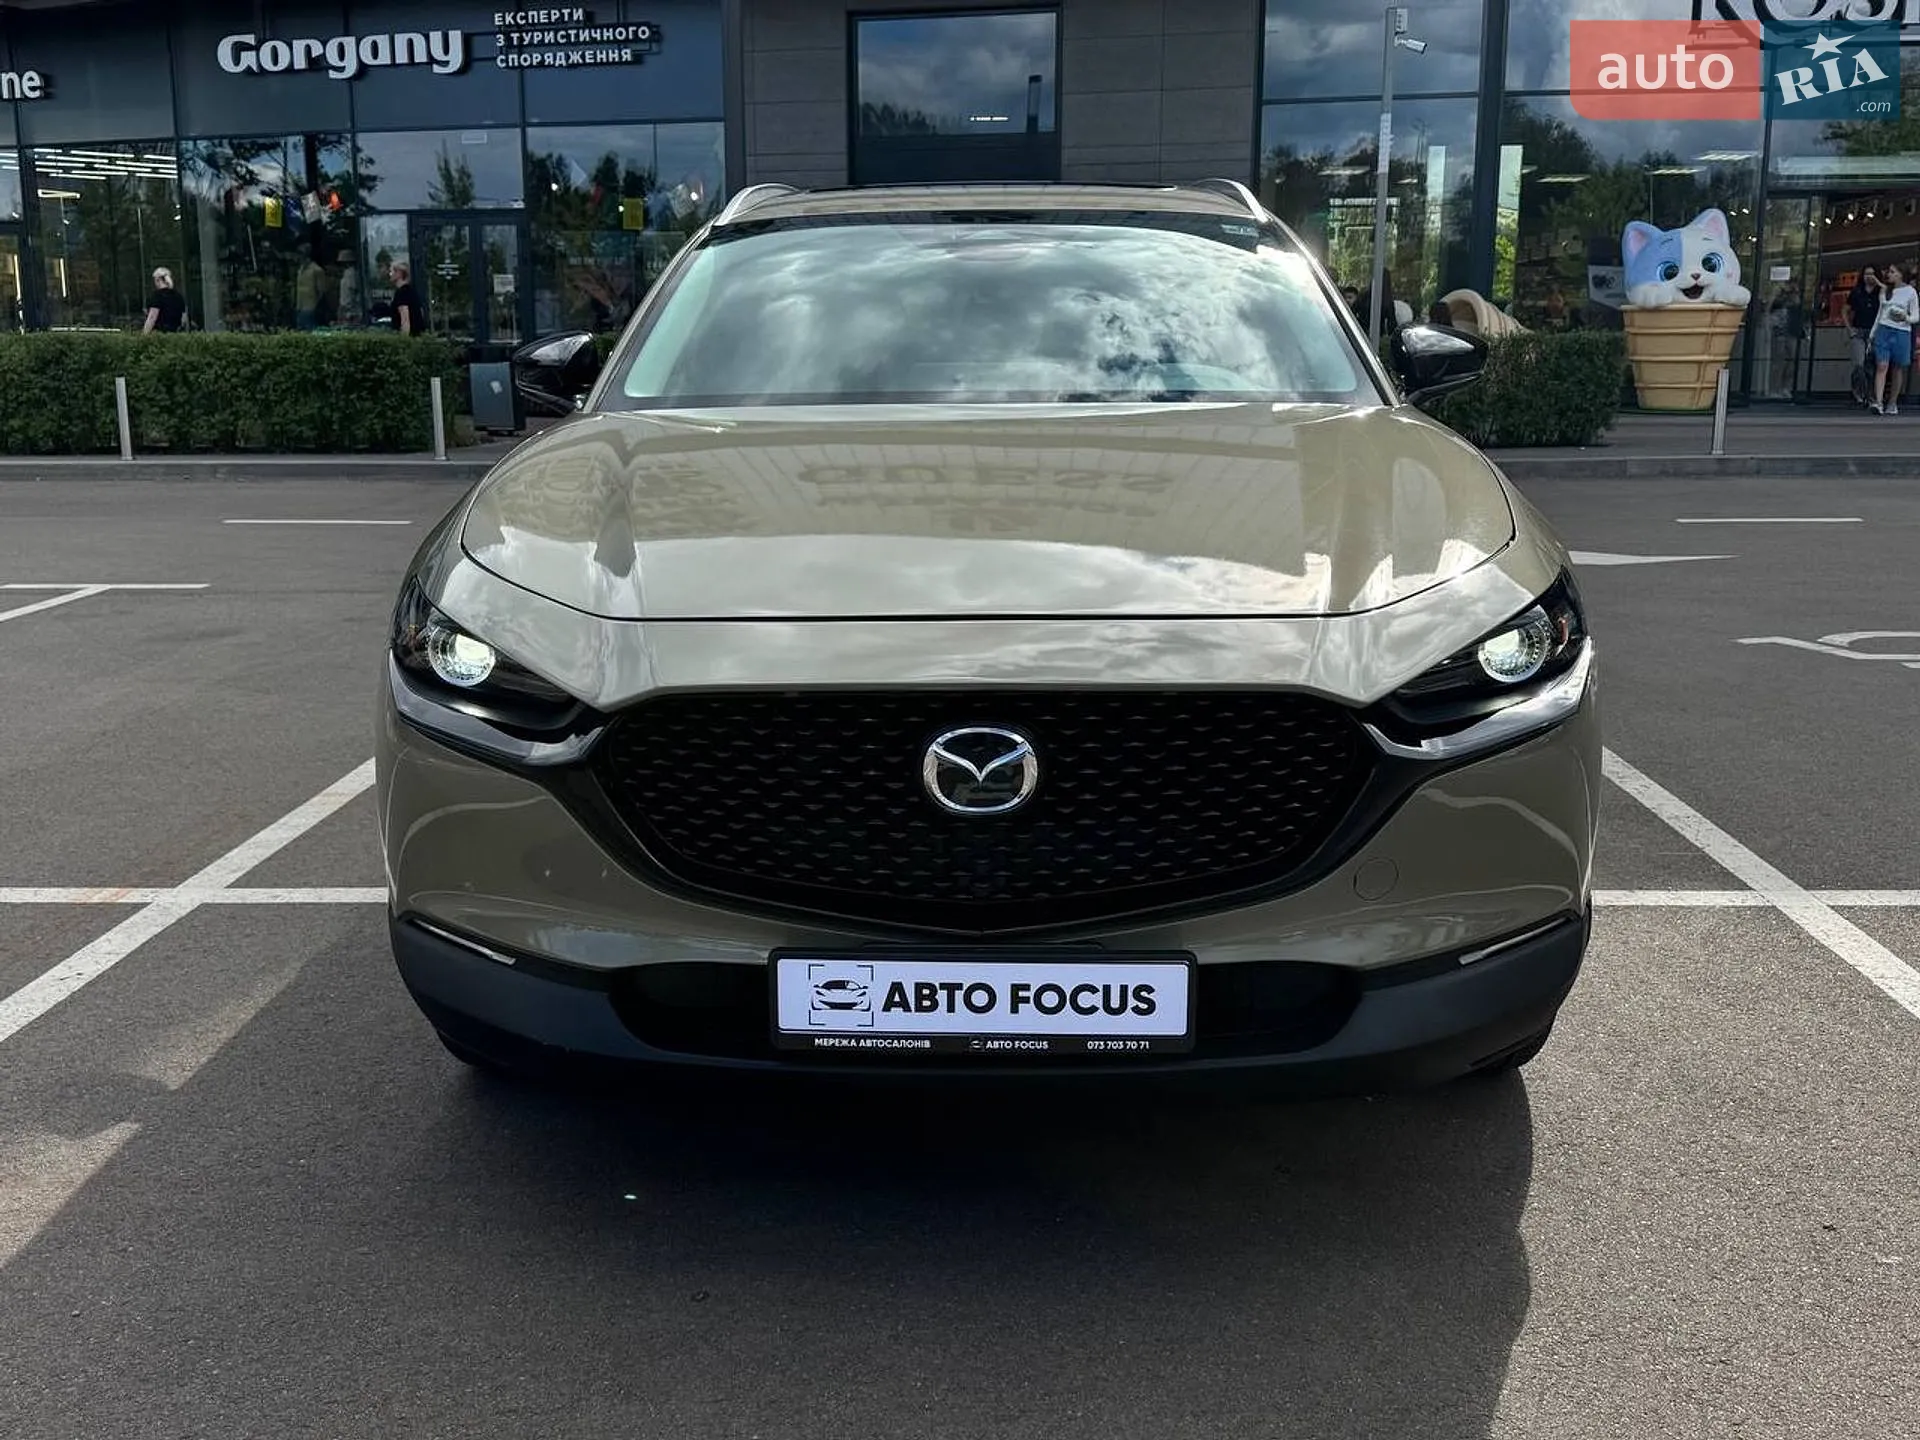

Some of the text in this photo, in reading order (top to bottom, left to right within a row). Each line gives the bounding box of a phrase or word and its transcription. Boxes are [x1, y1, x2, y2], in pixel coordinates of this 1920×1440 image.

[494, 7, 585, 26] ЕКСПЕРТИ
[511, 26, 650, 46] ТУРИСТИЧНОГО
[217, 30, 462, 79] Gorgany
[496, 49, 633, 68] СПОРЯДЖЕННЯ
[882, 981, 1157, 1016] АВТО FOCUS
[814, 1037, 932, 1049] МЕРЕЖА АВТОСАЛОНІВ
[1014, 1040, 1050, 1050] FOCUS
[1087, 1041, 1150, 1049] 073 703 70 71
